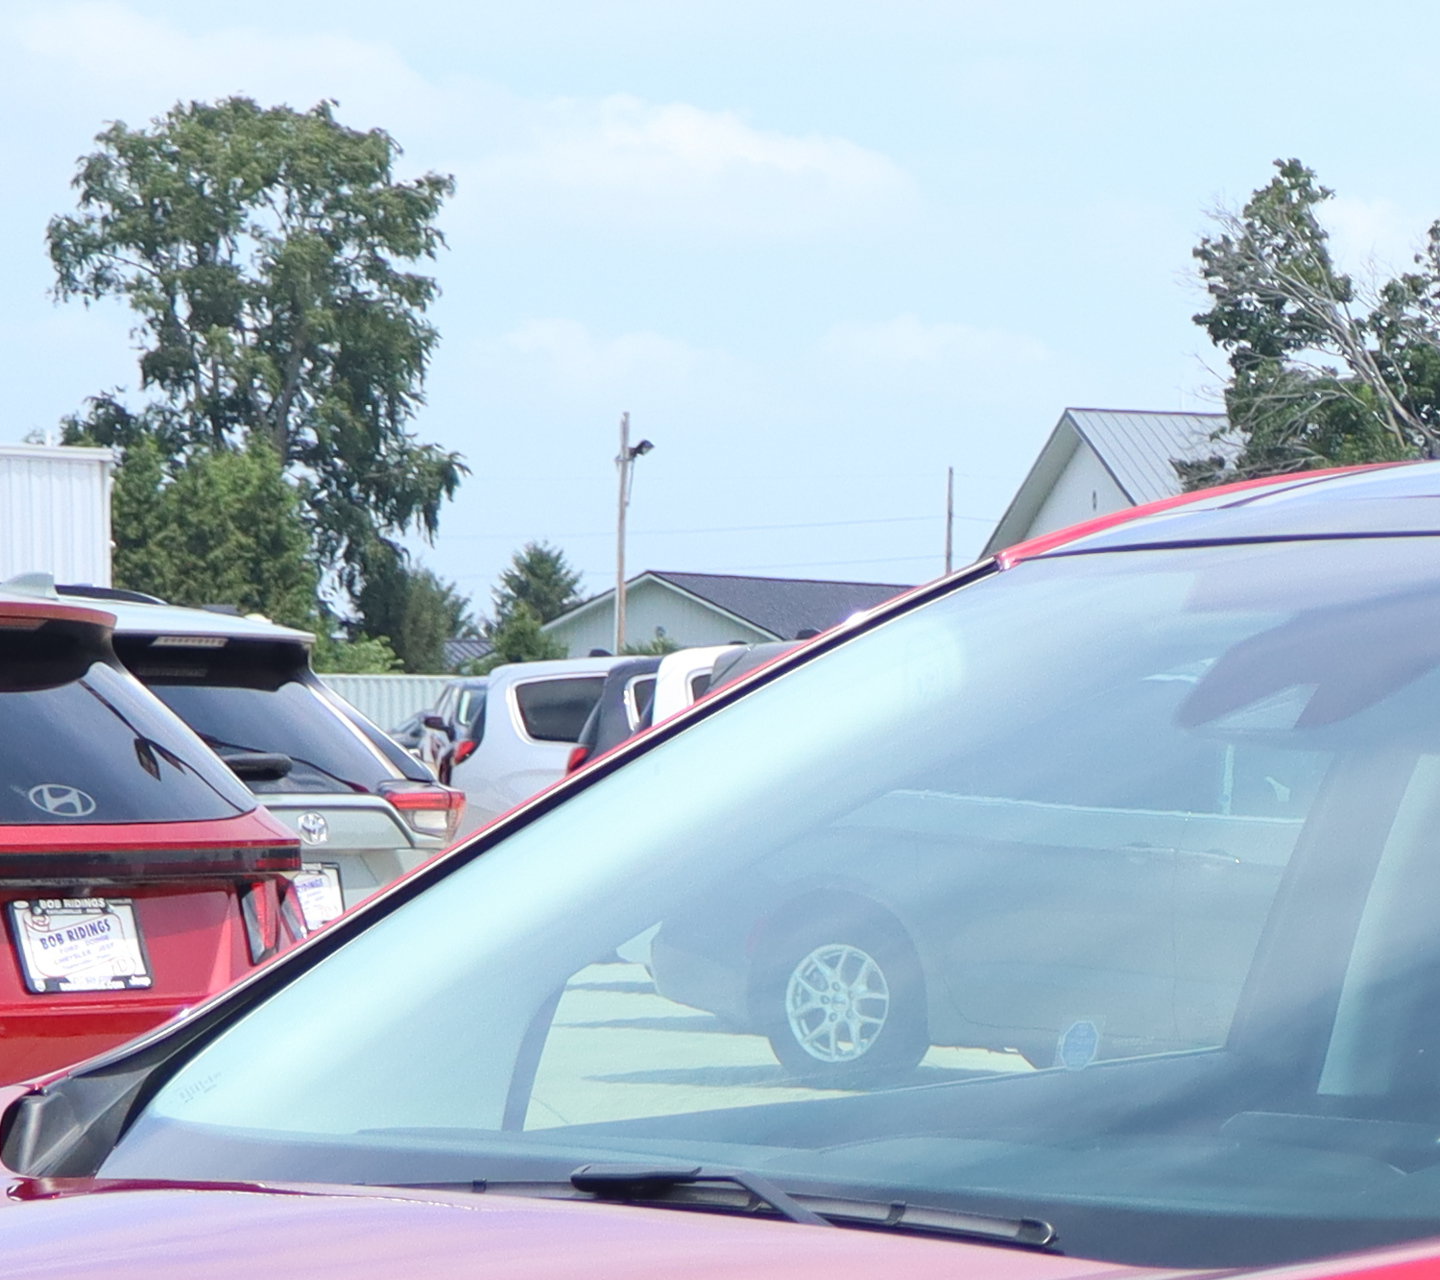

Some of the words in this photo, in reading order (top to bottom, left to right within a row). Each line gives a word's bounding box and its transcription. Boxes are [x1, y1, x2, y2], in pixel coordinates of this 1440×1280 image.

[39, 899, 62, 909] BOB
[63, 898, 106, 908] RIDINGS
[40, 932, 64, 950] BOB
[67, 919, 111, 941] RIDINGS
